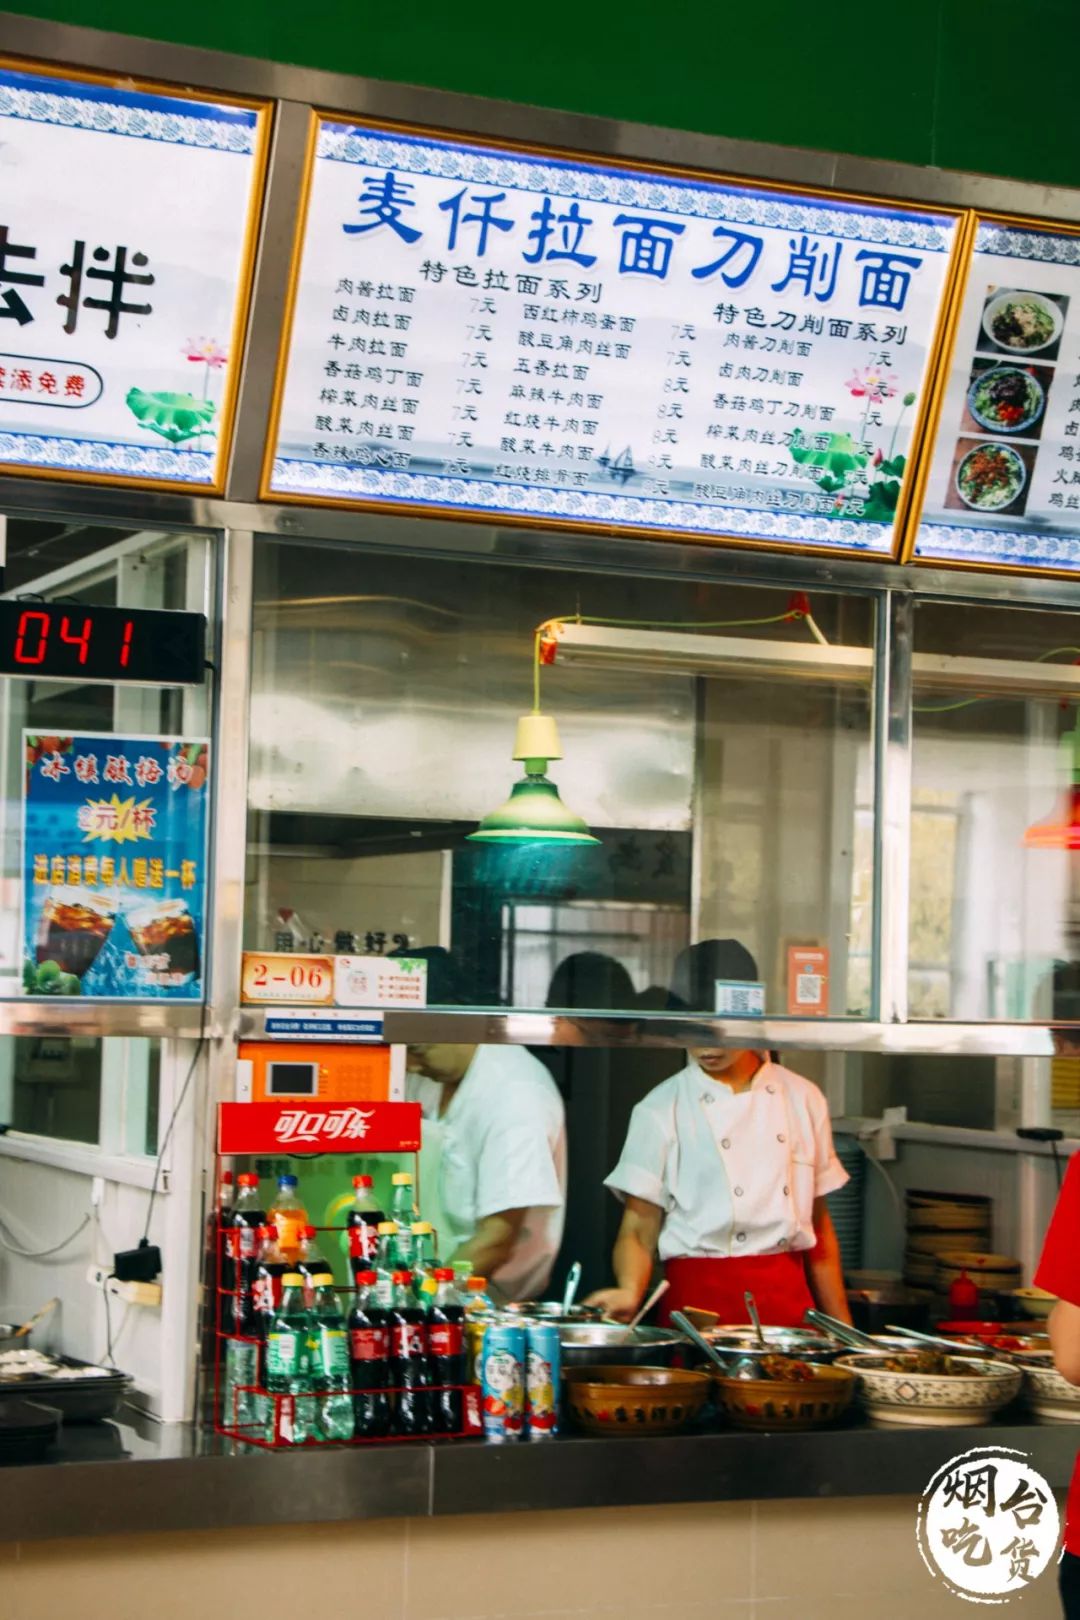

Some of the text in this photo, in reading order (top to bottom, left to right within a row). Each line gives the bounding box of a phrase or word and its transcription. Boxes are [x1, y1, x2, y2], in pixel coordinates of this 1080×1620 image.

[343, 172, 923, 312] 麦仟拉面刀削面
[335, 277, 416, 304] 肉酱拉面
[419, 260, 603, 304] 特色拉面系列
[332, 305, 413, 332] 卤肉拉面
[523, 303, 637, 334] 西红柿鸡蛋面
[713, 303, 908, 346] 特色刀削面系列
[327, 333, 409, 359] 牛肉拉面
[518, 330, 632, 360] 酸豆角肉丝面
[723, 332, 813, 358] 肉酱刀削面
[323, 360, 425, 388] 香菇鸡丁面
[513, 357, 590, 382] 五香拉面
[718, 362, 804, 388] 卤肉刀削面
[509, 384, 604, 411] 麻辣牛肉面
[713, 392, 836, 422] 香菇鸡丁刀削面
[315, 414, 416, 442] 酸菜肉丝面
[503, 410, 599, 436] 红烧牛肉面
[499, 437, 595, 463] 酸菜牛肉面
[701, 453, 825, 482] 酸菜肉丝刀削面
[13, 610, 135, 668] 041
[253, 963, 323, 988] 2-06
[273, 1106, 376, 1143] 可口可乐
